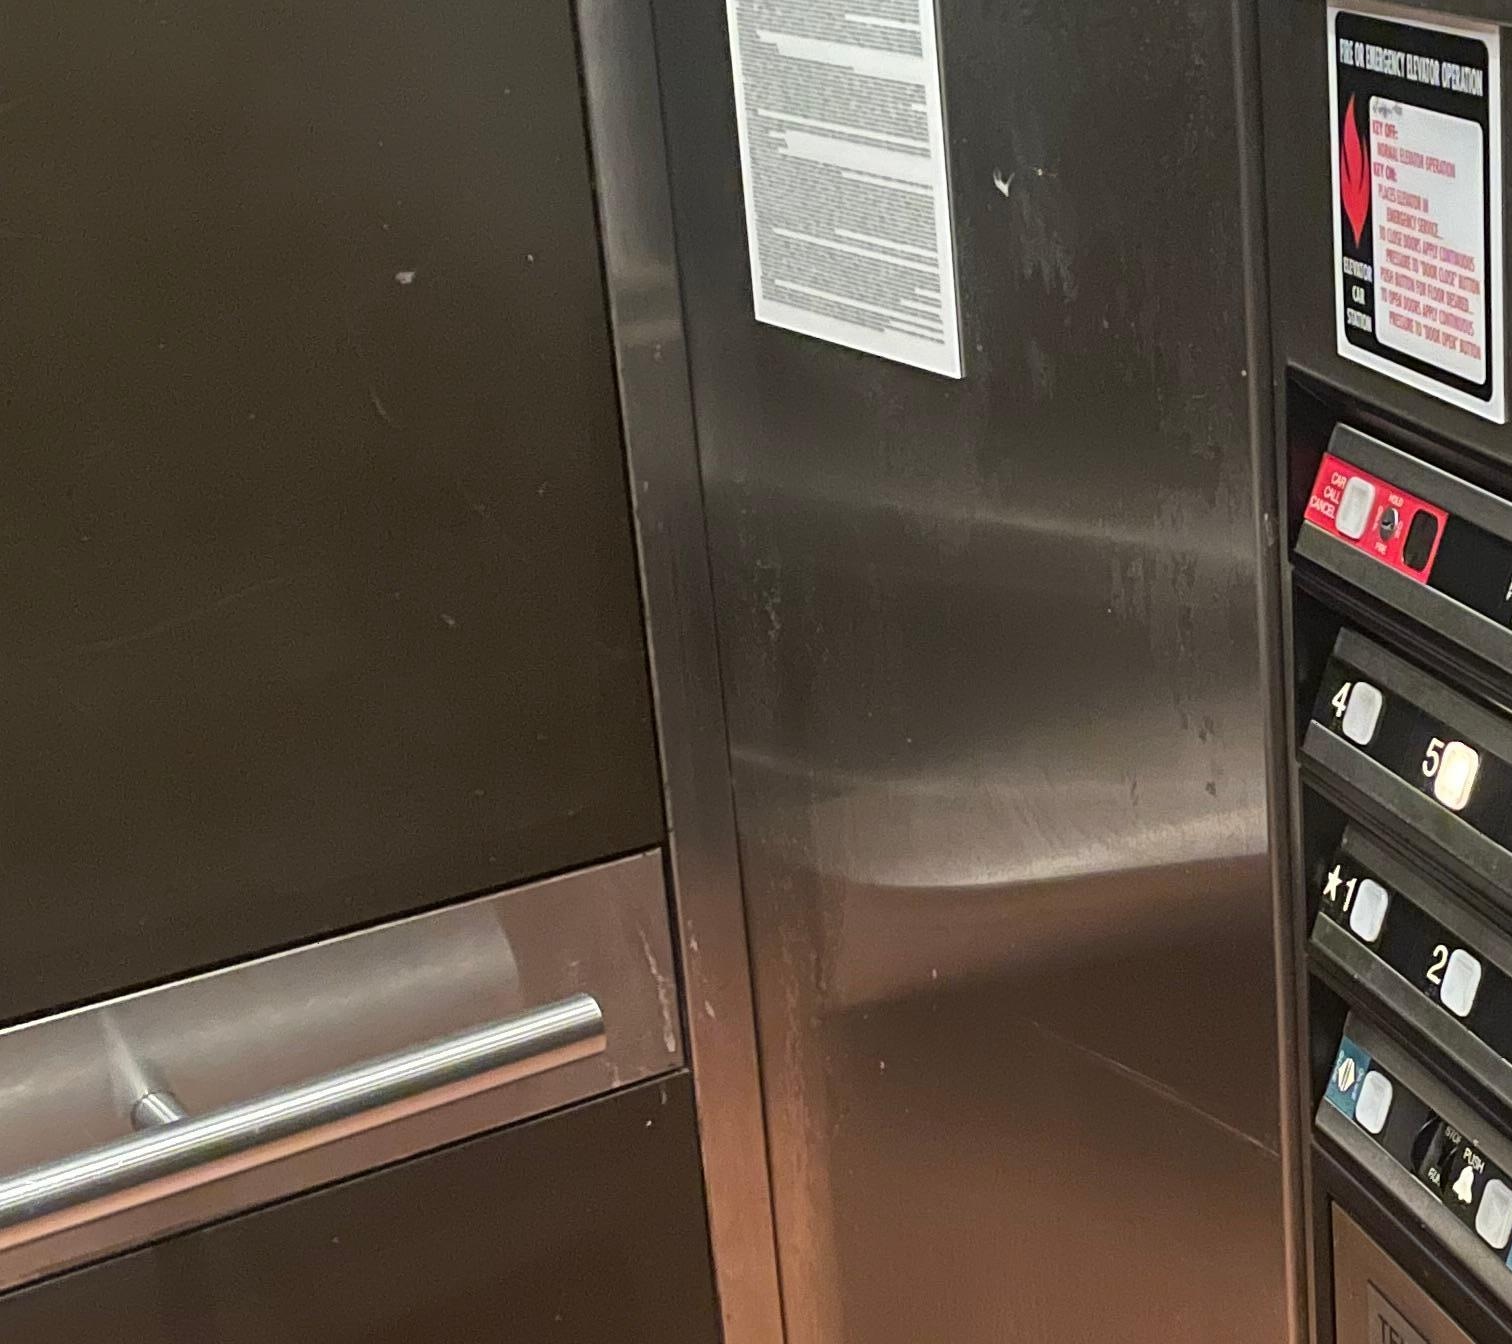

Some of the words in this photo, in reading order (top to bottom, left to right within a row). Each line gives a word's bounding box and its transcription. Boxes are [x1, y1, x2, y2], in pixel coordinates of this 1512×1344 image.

[1339, 38, 1354, 66] FIRE
[1365, 44, 1405, 78] EMERGENCY
[1406, 53, 1440, 86] ELEVATOR
[1441, 61, 1483, 97] OPERATION
[1324, 486, 1341, 505] CALL
[1331, 471, 1347, 490] CAR
[1310, 495, 1335, 519] CANCEL
[1331, 682, 1351, 718] 4
[1422, 737, 1445, 777] 5
[1343, 878, 1357, 912] 1
[1426, 944, 1449, 985] 2
[1463, 1147, 1485, 1174] PUSH
